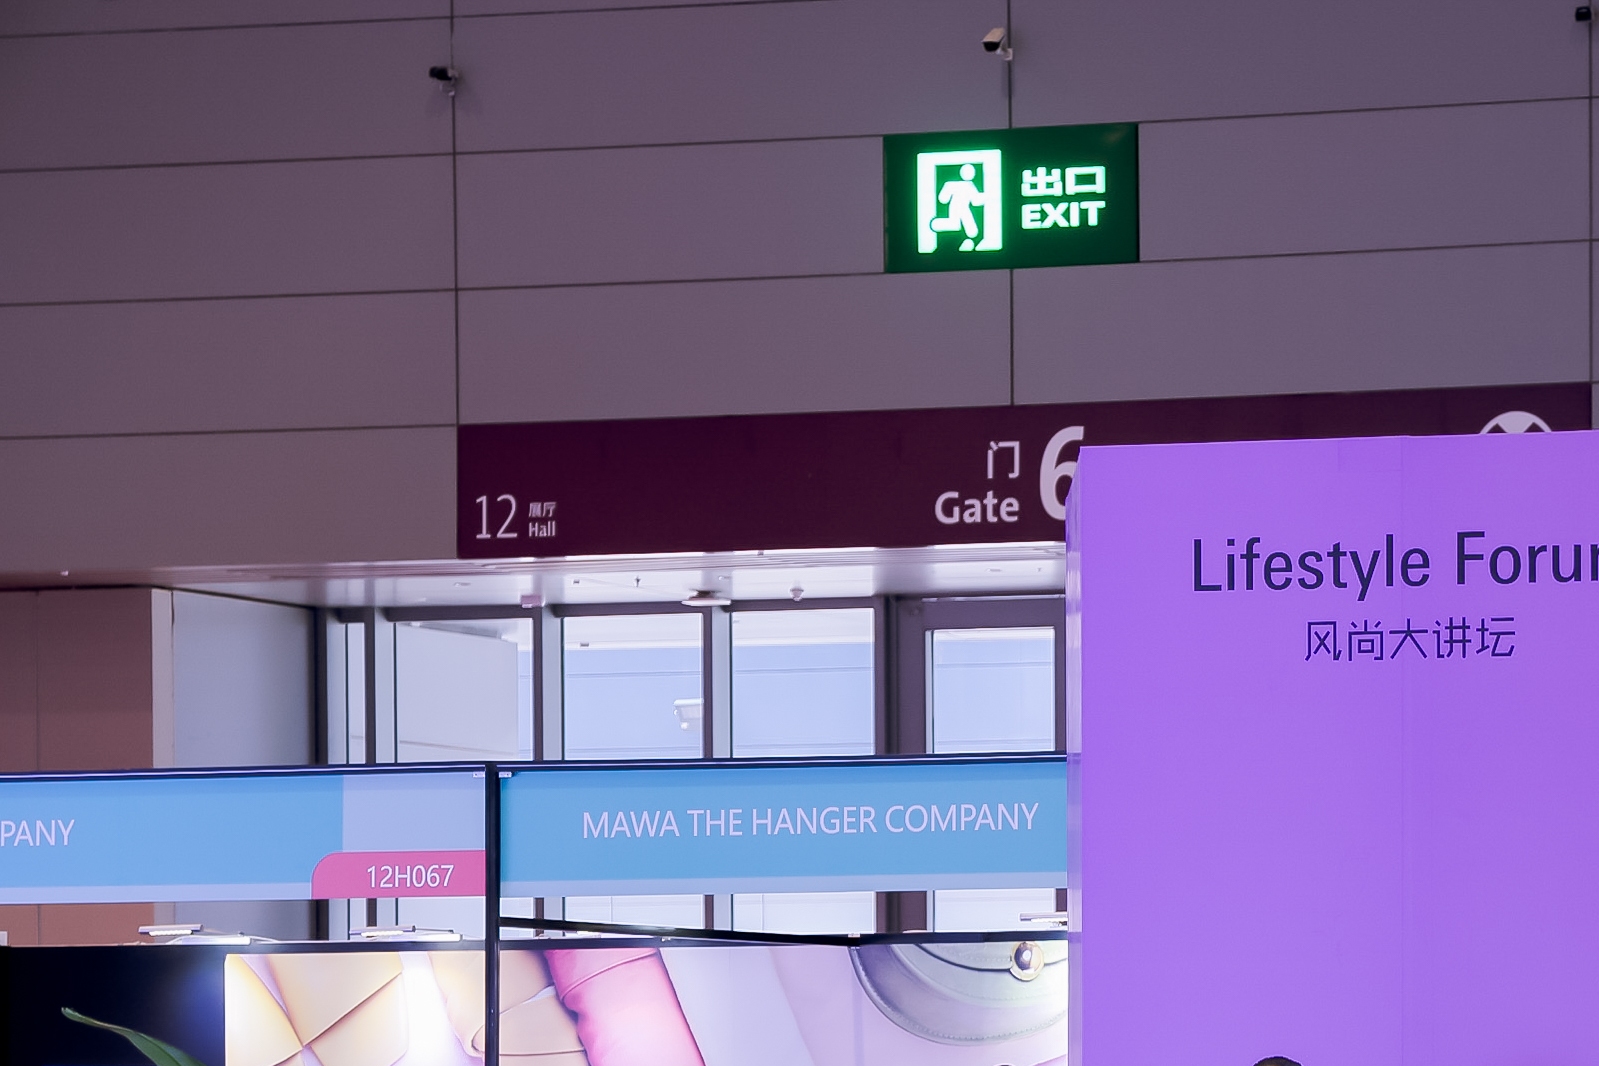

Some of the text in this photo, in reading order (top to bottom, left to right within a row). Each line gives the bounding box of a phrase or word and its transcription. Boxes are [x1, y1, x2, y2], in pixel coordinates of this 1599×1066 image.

[1020, 166, 1106, 197] 出口
[1021, 200, 1106, 229] EXIT
[934, 425, 1085, 525] Gate 6
[987, 440, 1020, 479] 门
[475, 493, 518, 539] 12
[528, 501, 557, 518] 展厅
[528, 520, 556, 537] Hall
[1192, 533, 1431, 602] Lifestyle
[1304, 616, 1516, 663] 风尚大讲坛
[0, 818, 76, 847] PANY
[582, 801, 1040, 840] MAWA THE HANGER COMPANY
[366, 864, 455, 889] 12H067
